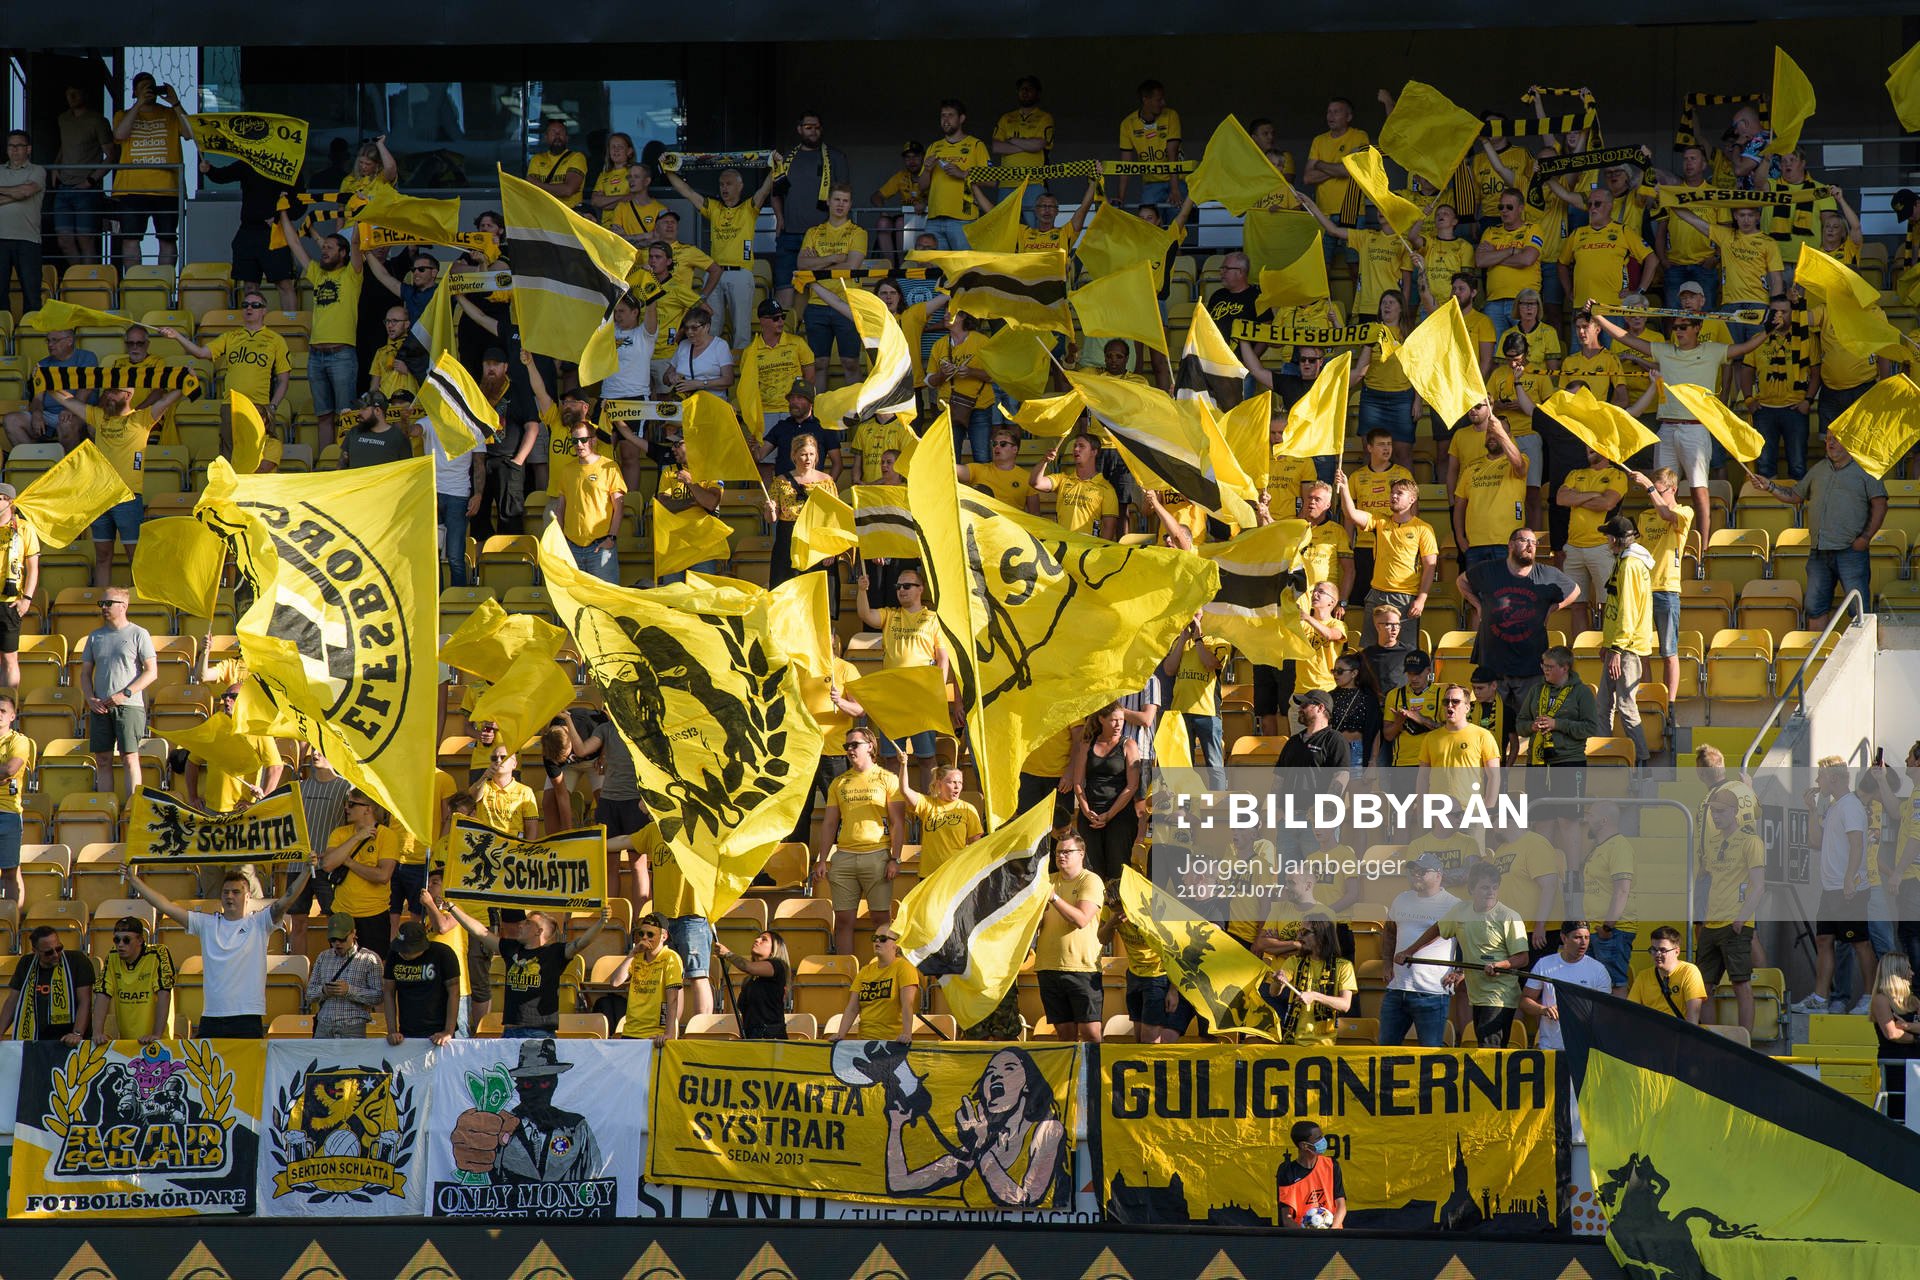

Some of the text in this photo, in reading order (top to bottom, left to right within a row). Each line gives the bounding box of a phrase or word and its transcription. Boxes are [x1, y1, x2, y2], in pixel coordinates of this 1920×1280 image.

[133, 139, 166, 147] adidas
[277, 126, 302, 144] 04
[1140, 146, 1167, 161] ello
[1541, 149, 1646, 174] LFSBORG
[1012, 164, 1065, 177] ELFSBORG
[1116, 164, 1170, 174] ELFSBORG
[1482, 177, 1504, 195] ello
[1675, 190, 1792, 204] ELFSBORG
[1241, 320, 1370, 343] IF ELFSBORG
[228, 347, 268, 367] ellos
[607, 409, 641, 419] pporter
[552, 437, 578, 457] ello
[198, 815, 297, 851] SCHLÄTTA
[503, 852, 589, 894] SCHLÄTTA
[394, 964, 422, 974] SEKTION
[119, 991, 149, 1000] CRAFT
[1111, 1050, 1546, 1120] GULIGANERNA
[679, 1074, 864, 1117] GULSVARTA
[693, 1111, 845, 1151] SYSTRAR
[727, 1148, 805, 1166] SEDAN 2013
[1324, 1134, 1350, 1163] 91
[291, 1161, 389, 1180] SEKTION SCHLÄTTA
[26, 1189, 246, 1212] FOTBOLLSMÖRDARE
[438, 1185, 511, 1213] ONLY
